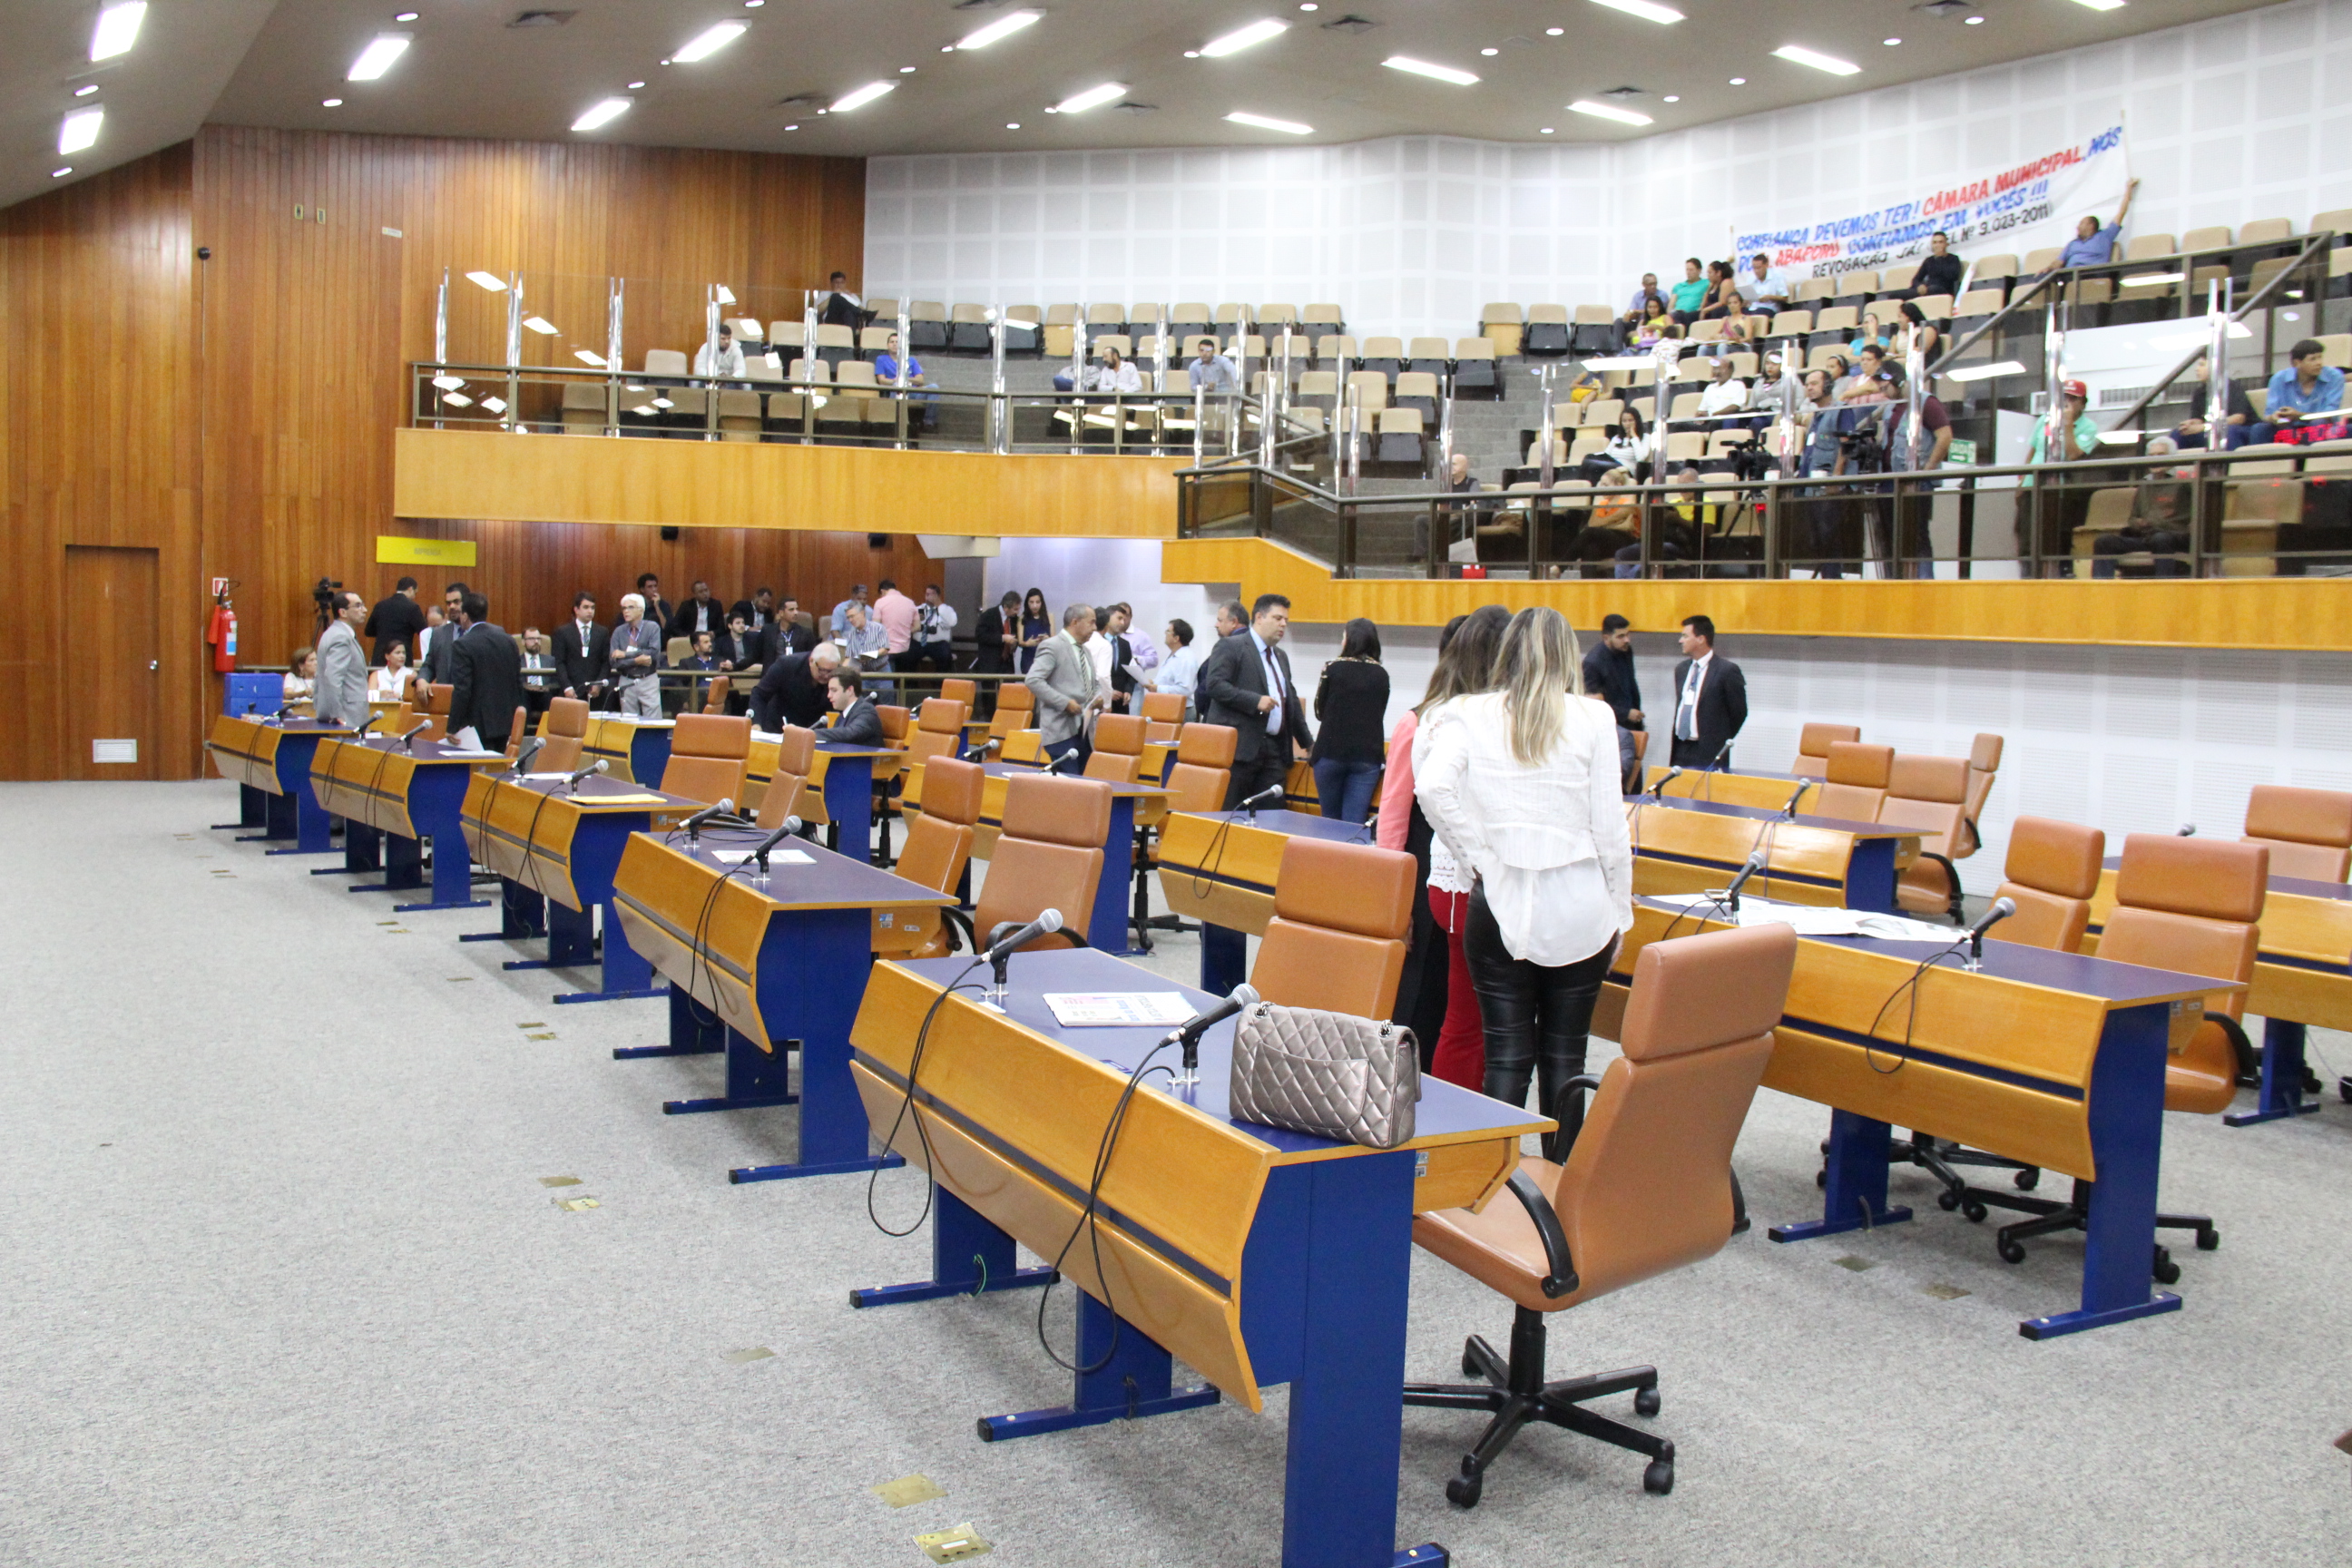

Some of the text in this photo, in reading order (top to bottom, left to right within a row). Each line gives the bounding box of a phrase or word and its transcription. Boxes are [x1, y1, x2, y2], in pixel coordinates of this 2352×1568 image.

[1814, 211, 1880, 241] DEVEMOS
[1885, 201, 1920, 226] TER!
[1940, 209, 1968, 231] EM
[1813, 251, 1888, 279] REVOGAÇÃO
